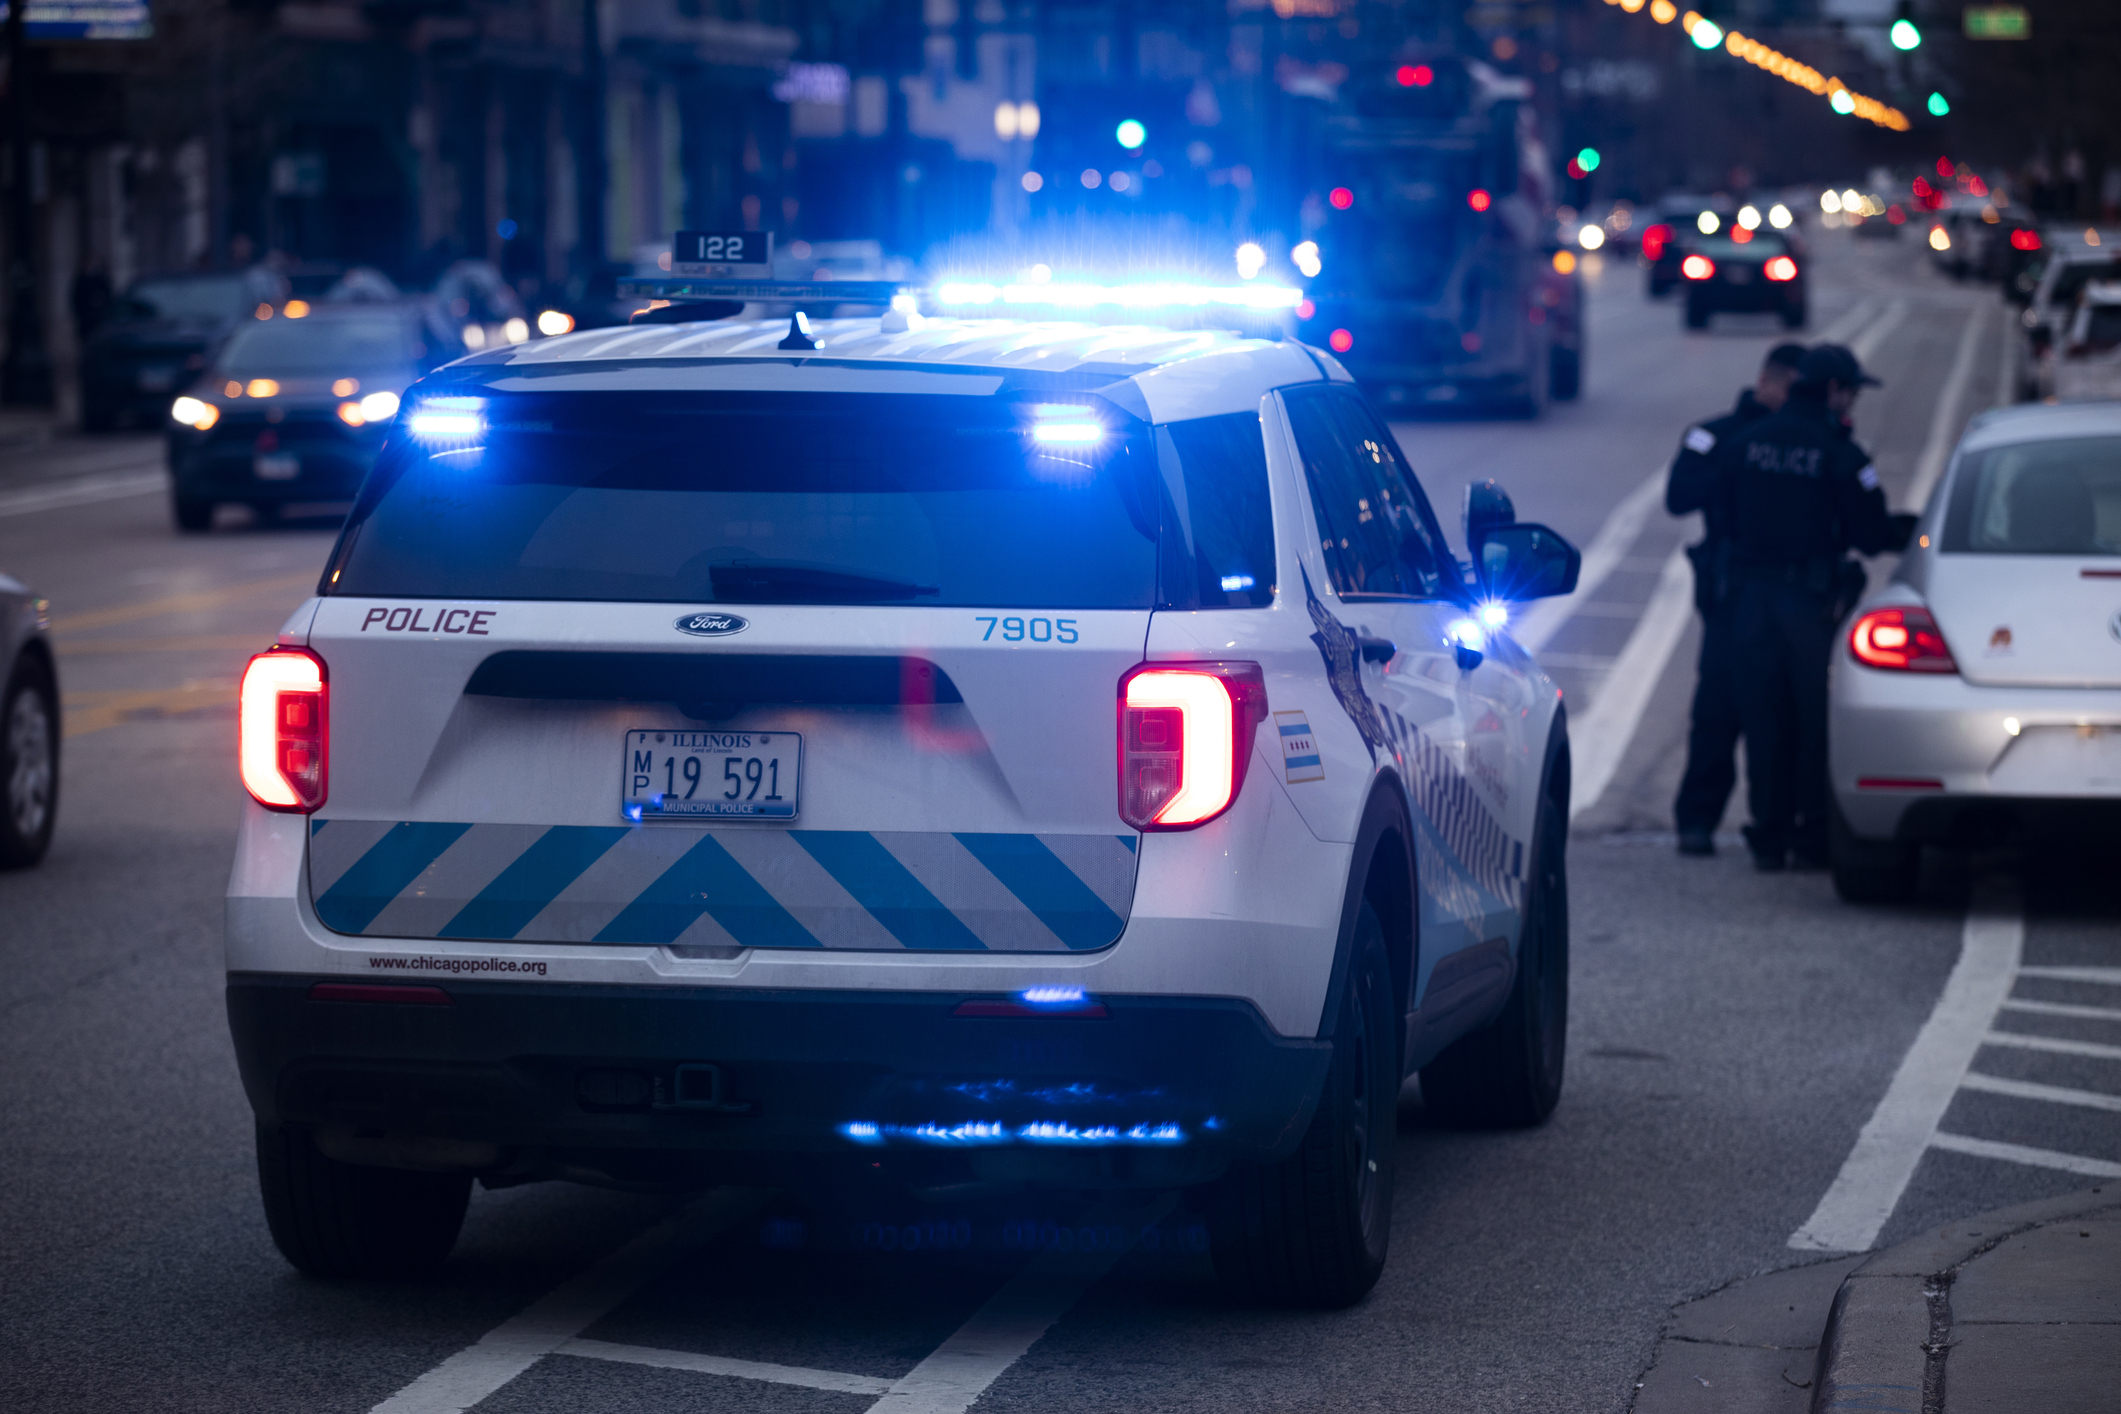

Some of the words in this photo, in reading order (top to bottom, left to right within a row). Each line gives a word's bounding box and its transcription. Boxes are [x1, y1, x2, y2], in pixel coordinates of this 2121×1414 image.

[698, 236, 744, 260] 122
[1746, 442, 1822, 477] POLICE
[361, 607, 497, 635] POLICE
[689, 615, 732, 630] Ford
[975, 616, 1079, 644] 7905
[672, 733, 752, 748] ILLINOIS
[661, 756, 701, 800] 19
[724, 757, 783, 801] 591
[663, 803, 718, 814] MUNICIPAL
[720, 803, 754, 814] POLICE
[369, 956, 547, 976] www.chicagopolice.org
